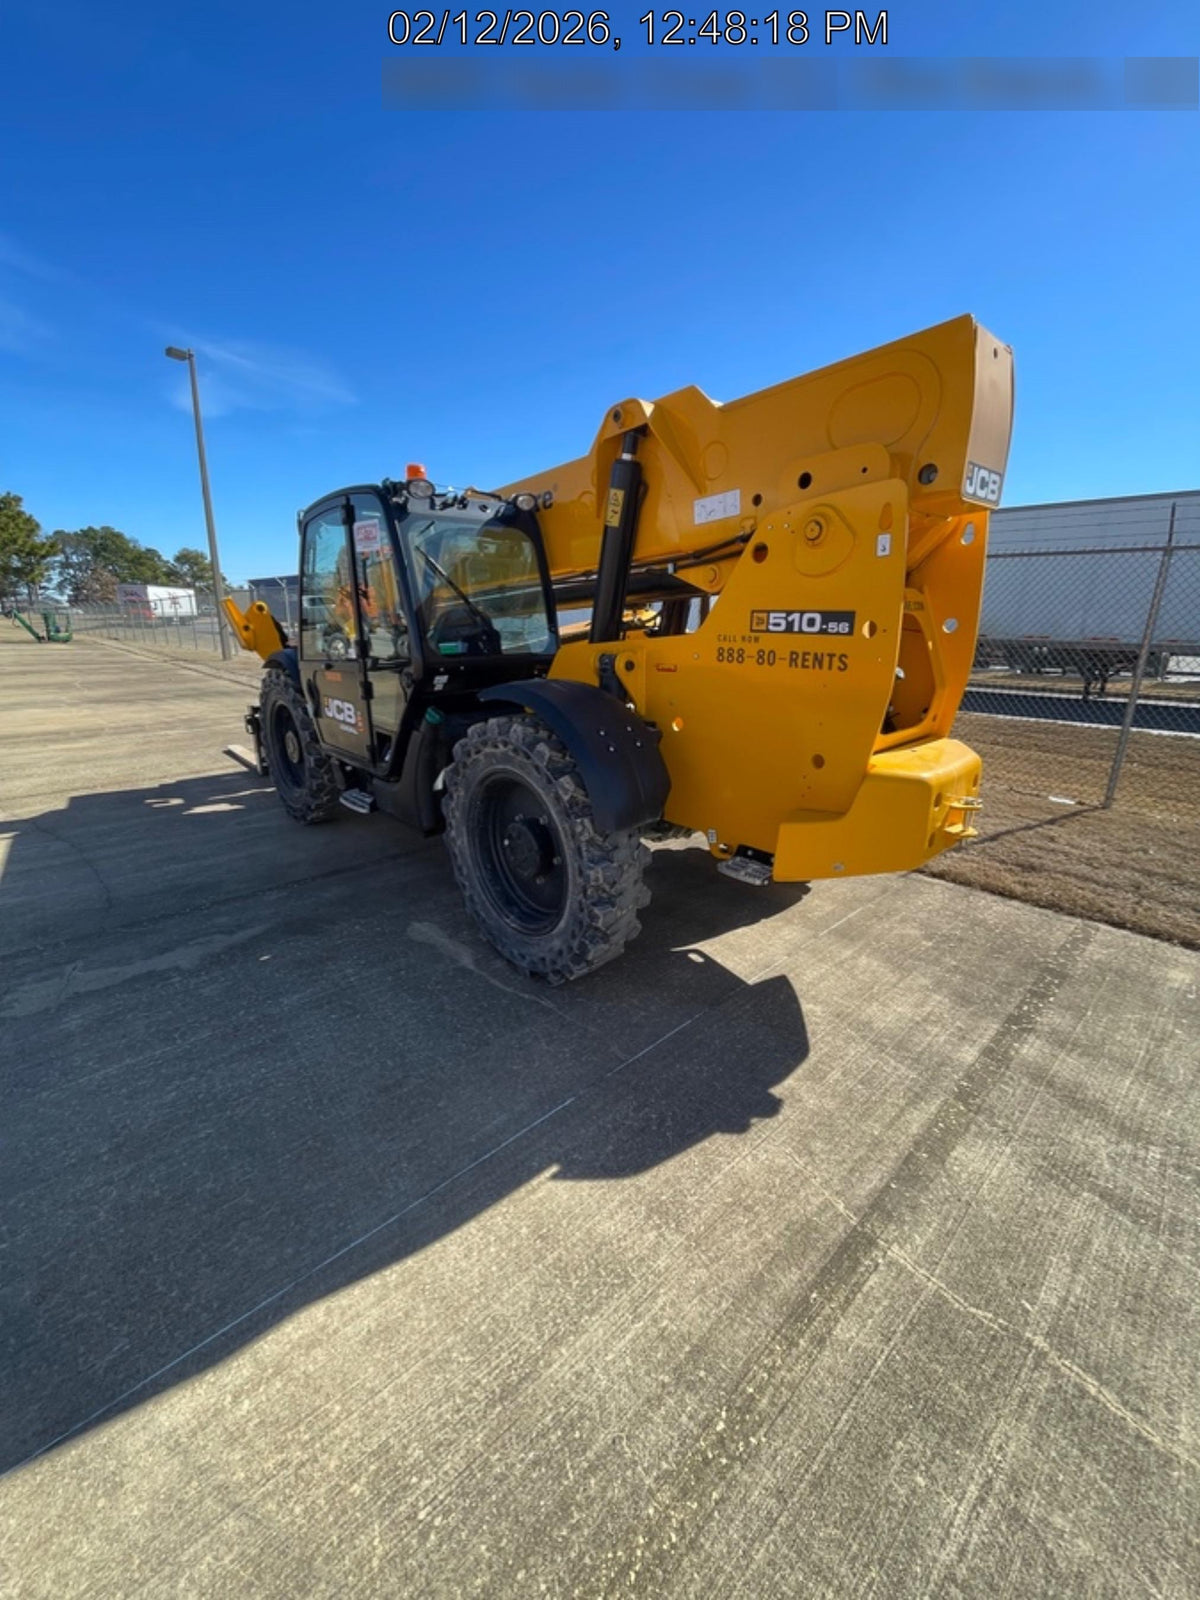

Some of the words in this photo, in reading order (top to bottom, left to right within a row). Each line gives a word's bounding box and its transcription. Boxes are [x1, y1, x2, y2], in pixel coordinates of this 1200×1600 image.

[965, 465, 1001, 502] JCB
[716, 646, 849, 672] 888-80-RENTS
[324, 697, 357, 725] JCB
